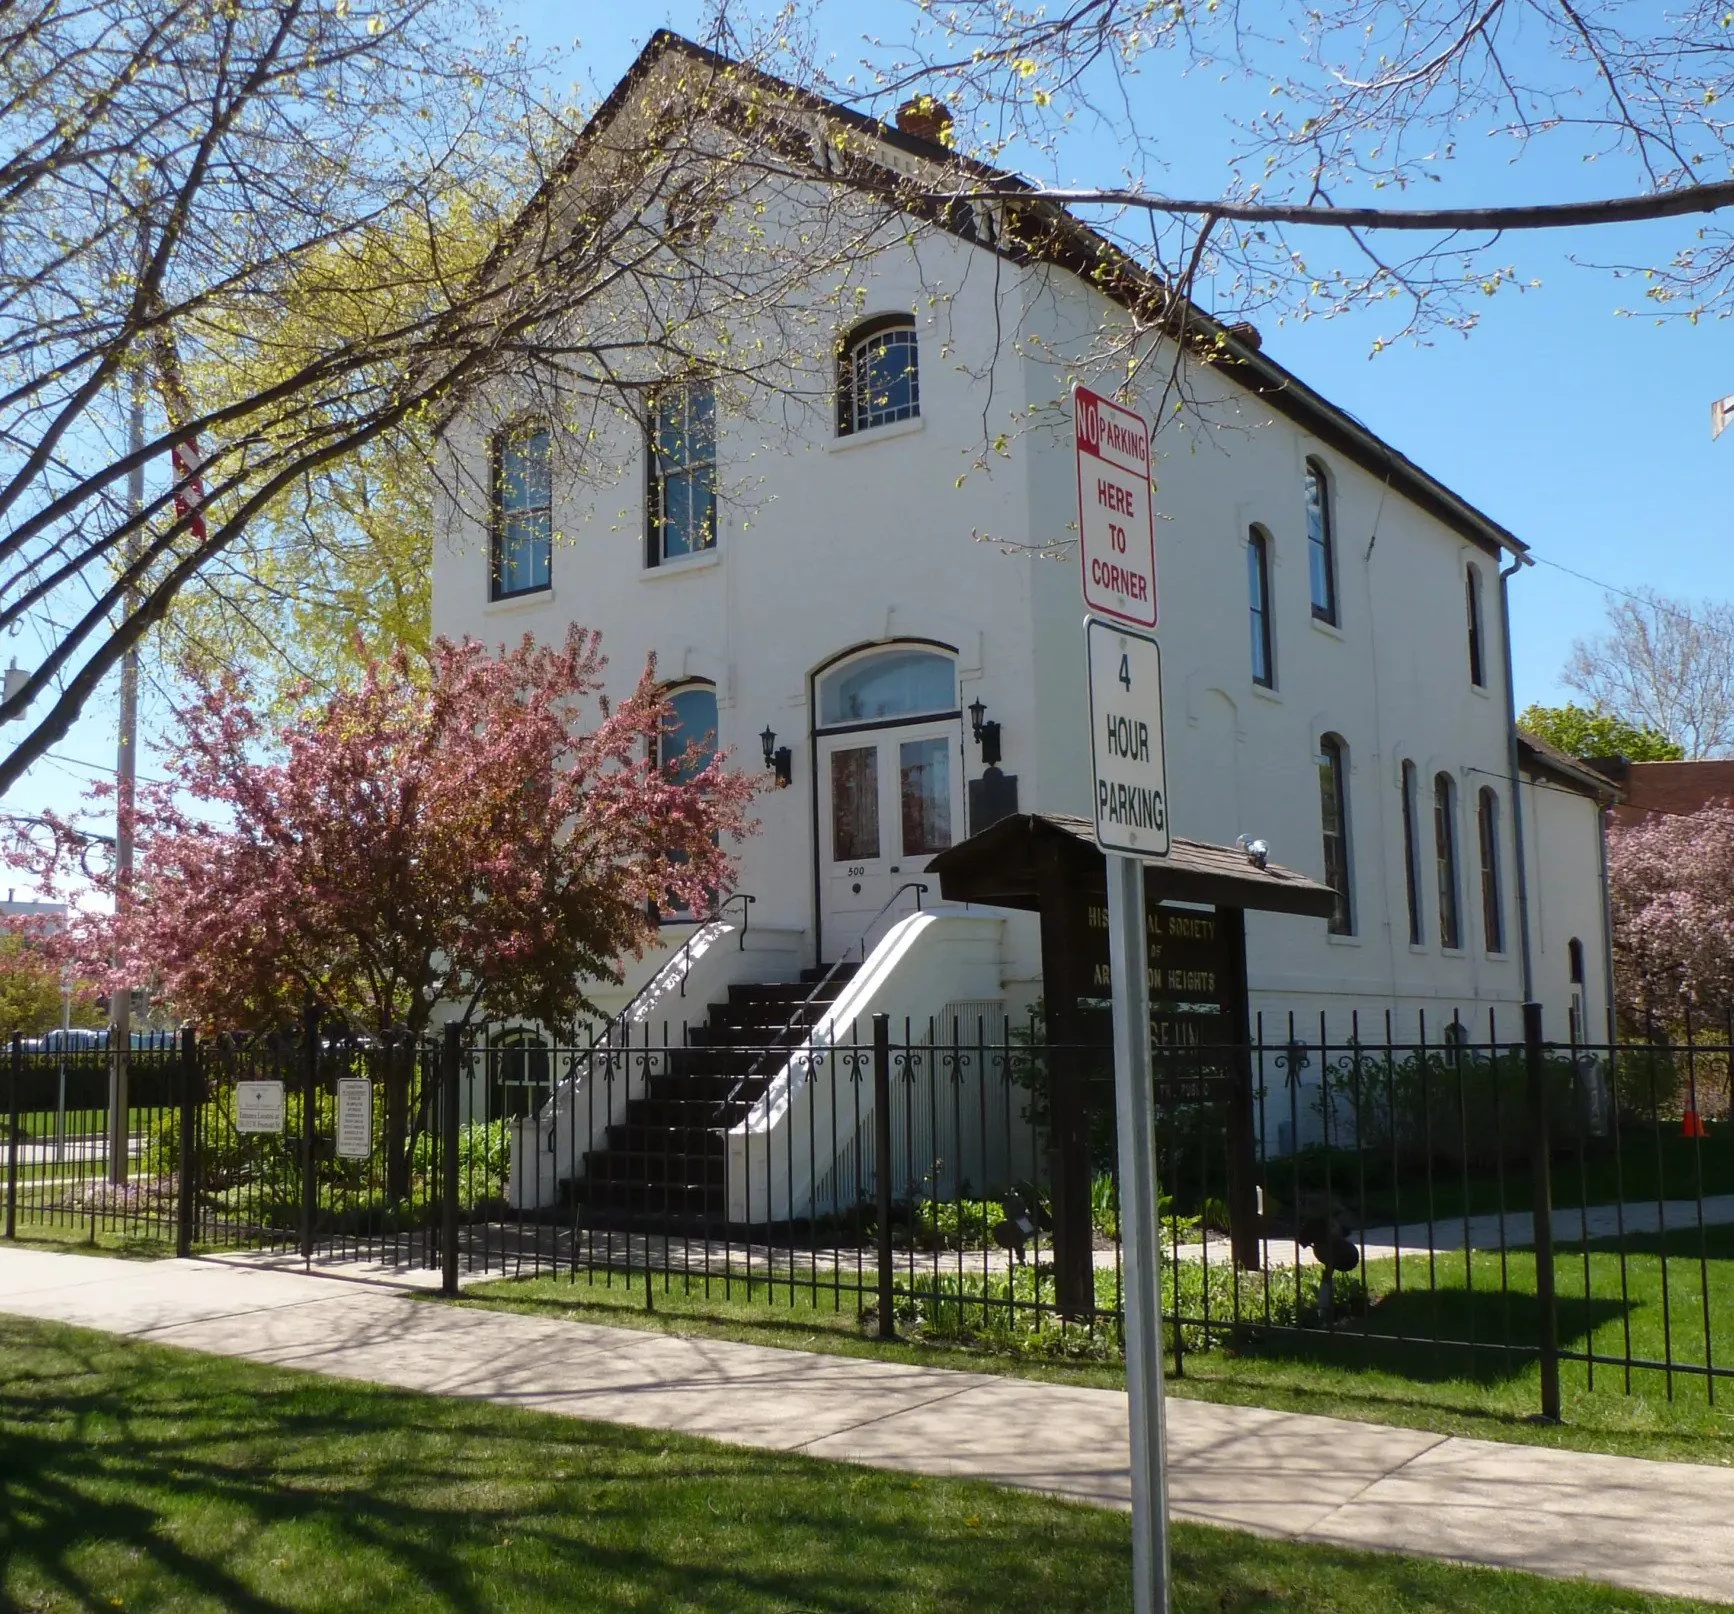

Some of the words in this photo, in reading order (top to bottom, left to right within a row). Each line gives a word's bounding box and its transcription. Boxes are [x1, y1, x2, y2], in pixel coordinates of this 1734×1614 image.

[1077, 398, 1098, 445] NO
[1099, 416, 1146, 462] PARKING
[1097, 478, 1134, 518] HERE
[1108, 523, 1126, 554] TO
[1092, 558, 1148, 602] CORNER
[1118, 653, 1131, 693] 4
[1106, 713, 1150, 763] HOUR
[1098, 779, 1164, 832] PARKING
[848, 866, 865, 877] 500
[1168, 915, 1216, 941] SOCIETY
[1151, 943, 1163, 958] OF
[1167, 968, 1216, 993] HEIGHTS
